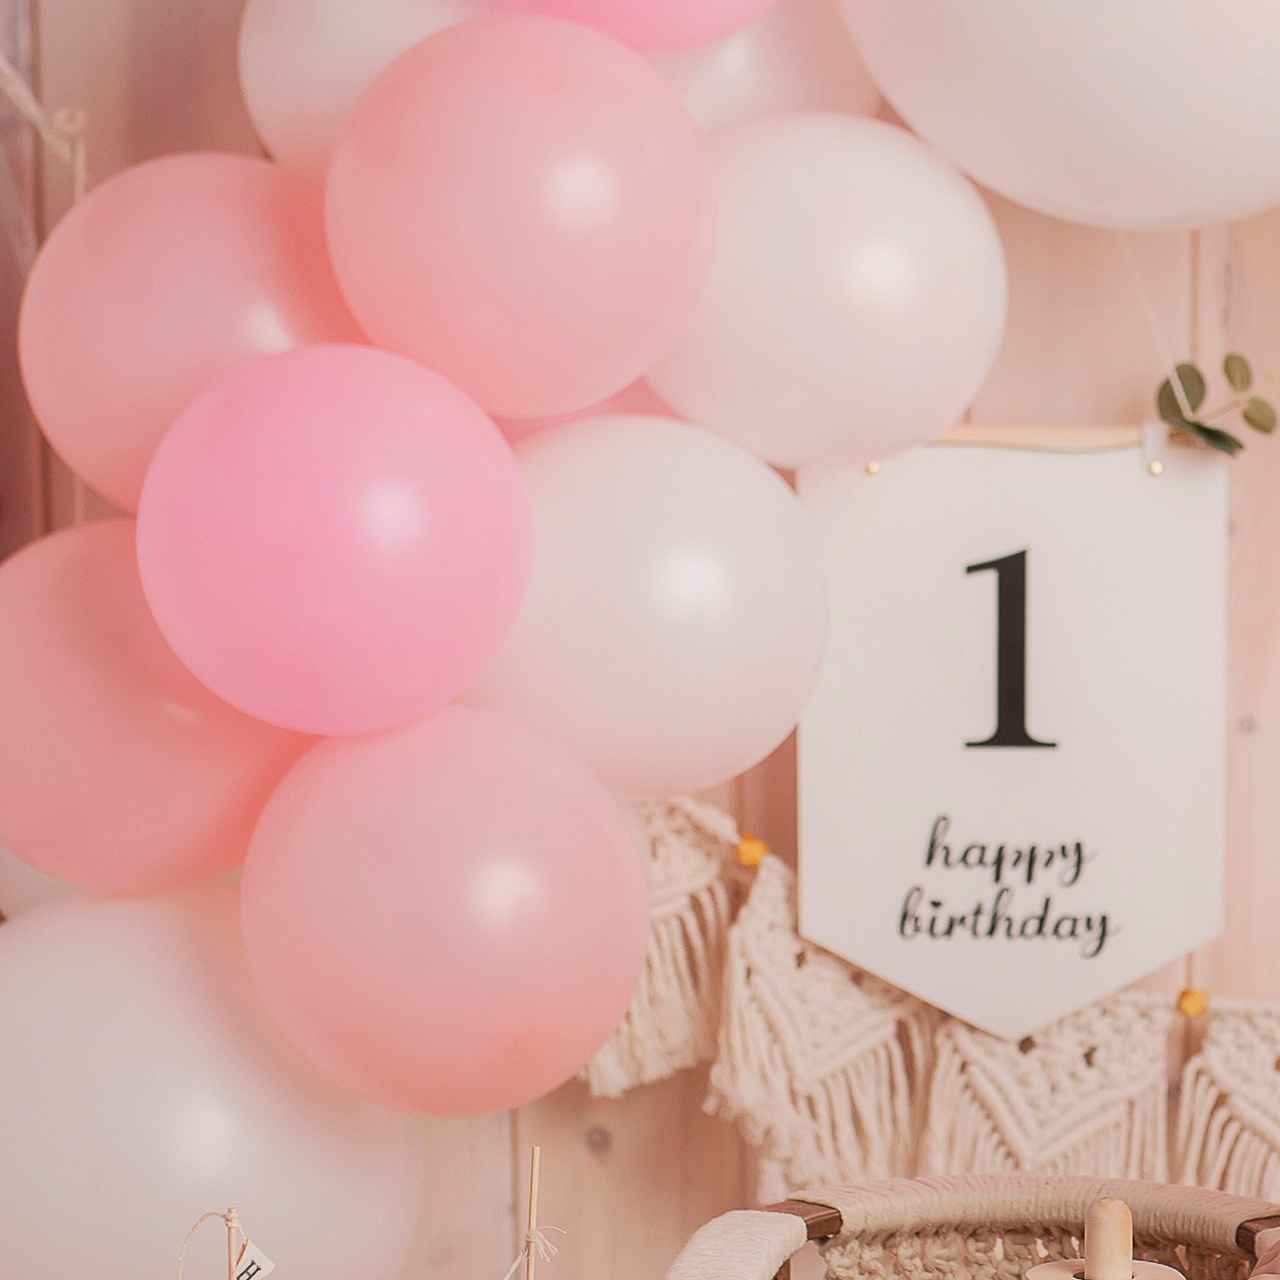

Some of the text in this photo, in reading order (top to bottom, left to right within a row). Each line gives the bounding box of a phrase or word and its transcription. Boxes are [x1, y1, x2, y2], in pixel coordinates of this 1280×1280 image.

[964, 548, 1058, 749] 1
[925, 815, 1094, 888] happy
[898, 886, 1119, 959] birthday
